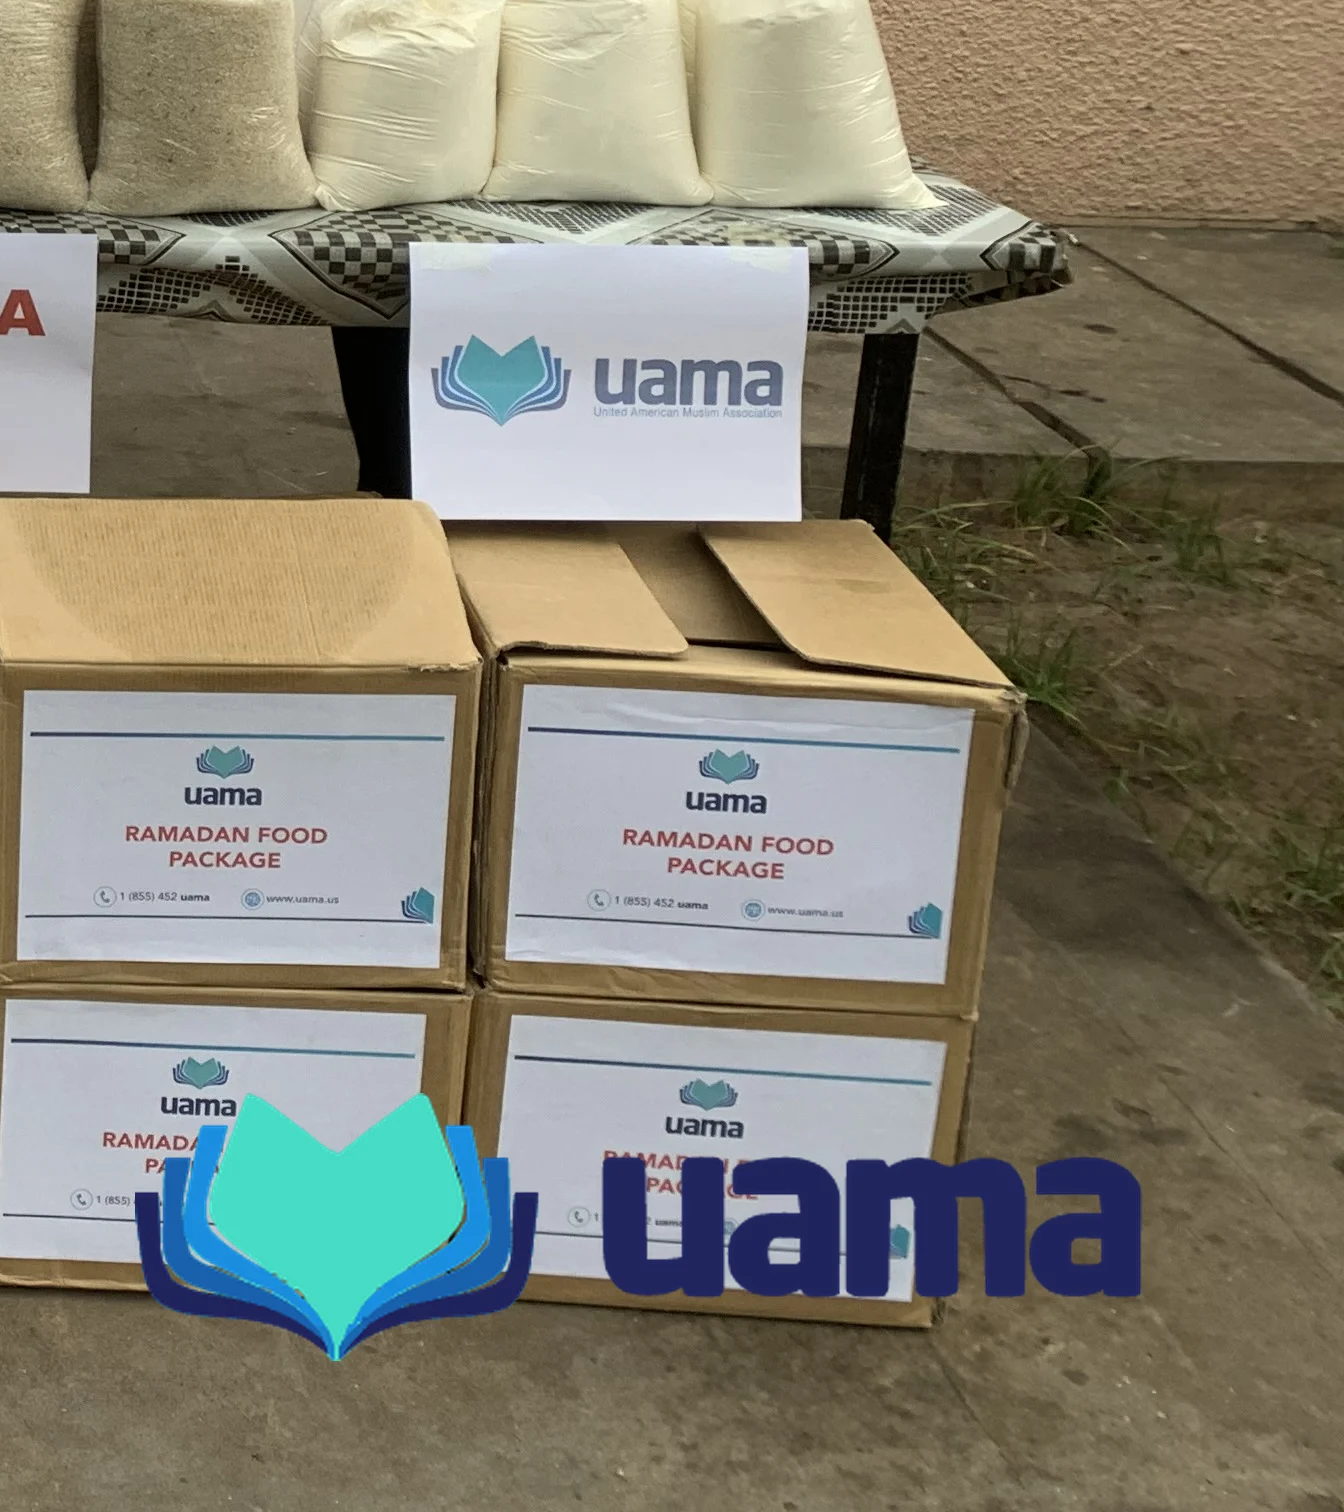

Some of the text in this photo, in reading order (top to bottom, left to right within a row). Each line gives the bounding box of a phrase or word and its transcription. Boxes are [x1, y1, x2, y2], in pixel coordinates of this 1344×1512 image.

[595, 358, 783, 406] uama
[594, 407, 782, 418] United American Muslim Association
[185, 787, 262, 805] uama
[686, 792, 767, 814] uama
[126, 826, 327, 844] RAMADAN FOOD
[623, 829, 833, 855] RAMADAN FOOD
[170, 851, 280, 868] PACKAGE
[668, 858, 784, 879] PACKAGE
[129, 892, 155, 902] (855)
[158, 892, 177, 901] 452
[266, 896, 339, 904] www.uama.us
[161, 1096, 237, 1116] uama
[665, 1117, 744, 1138] uama
[103, 1132, 200, 1151] RAMAD
[105, 1195, 130, 1206] (855)
